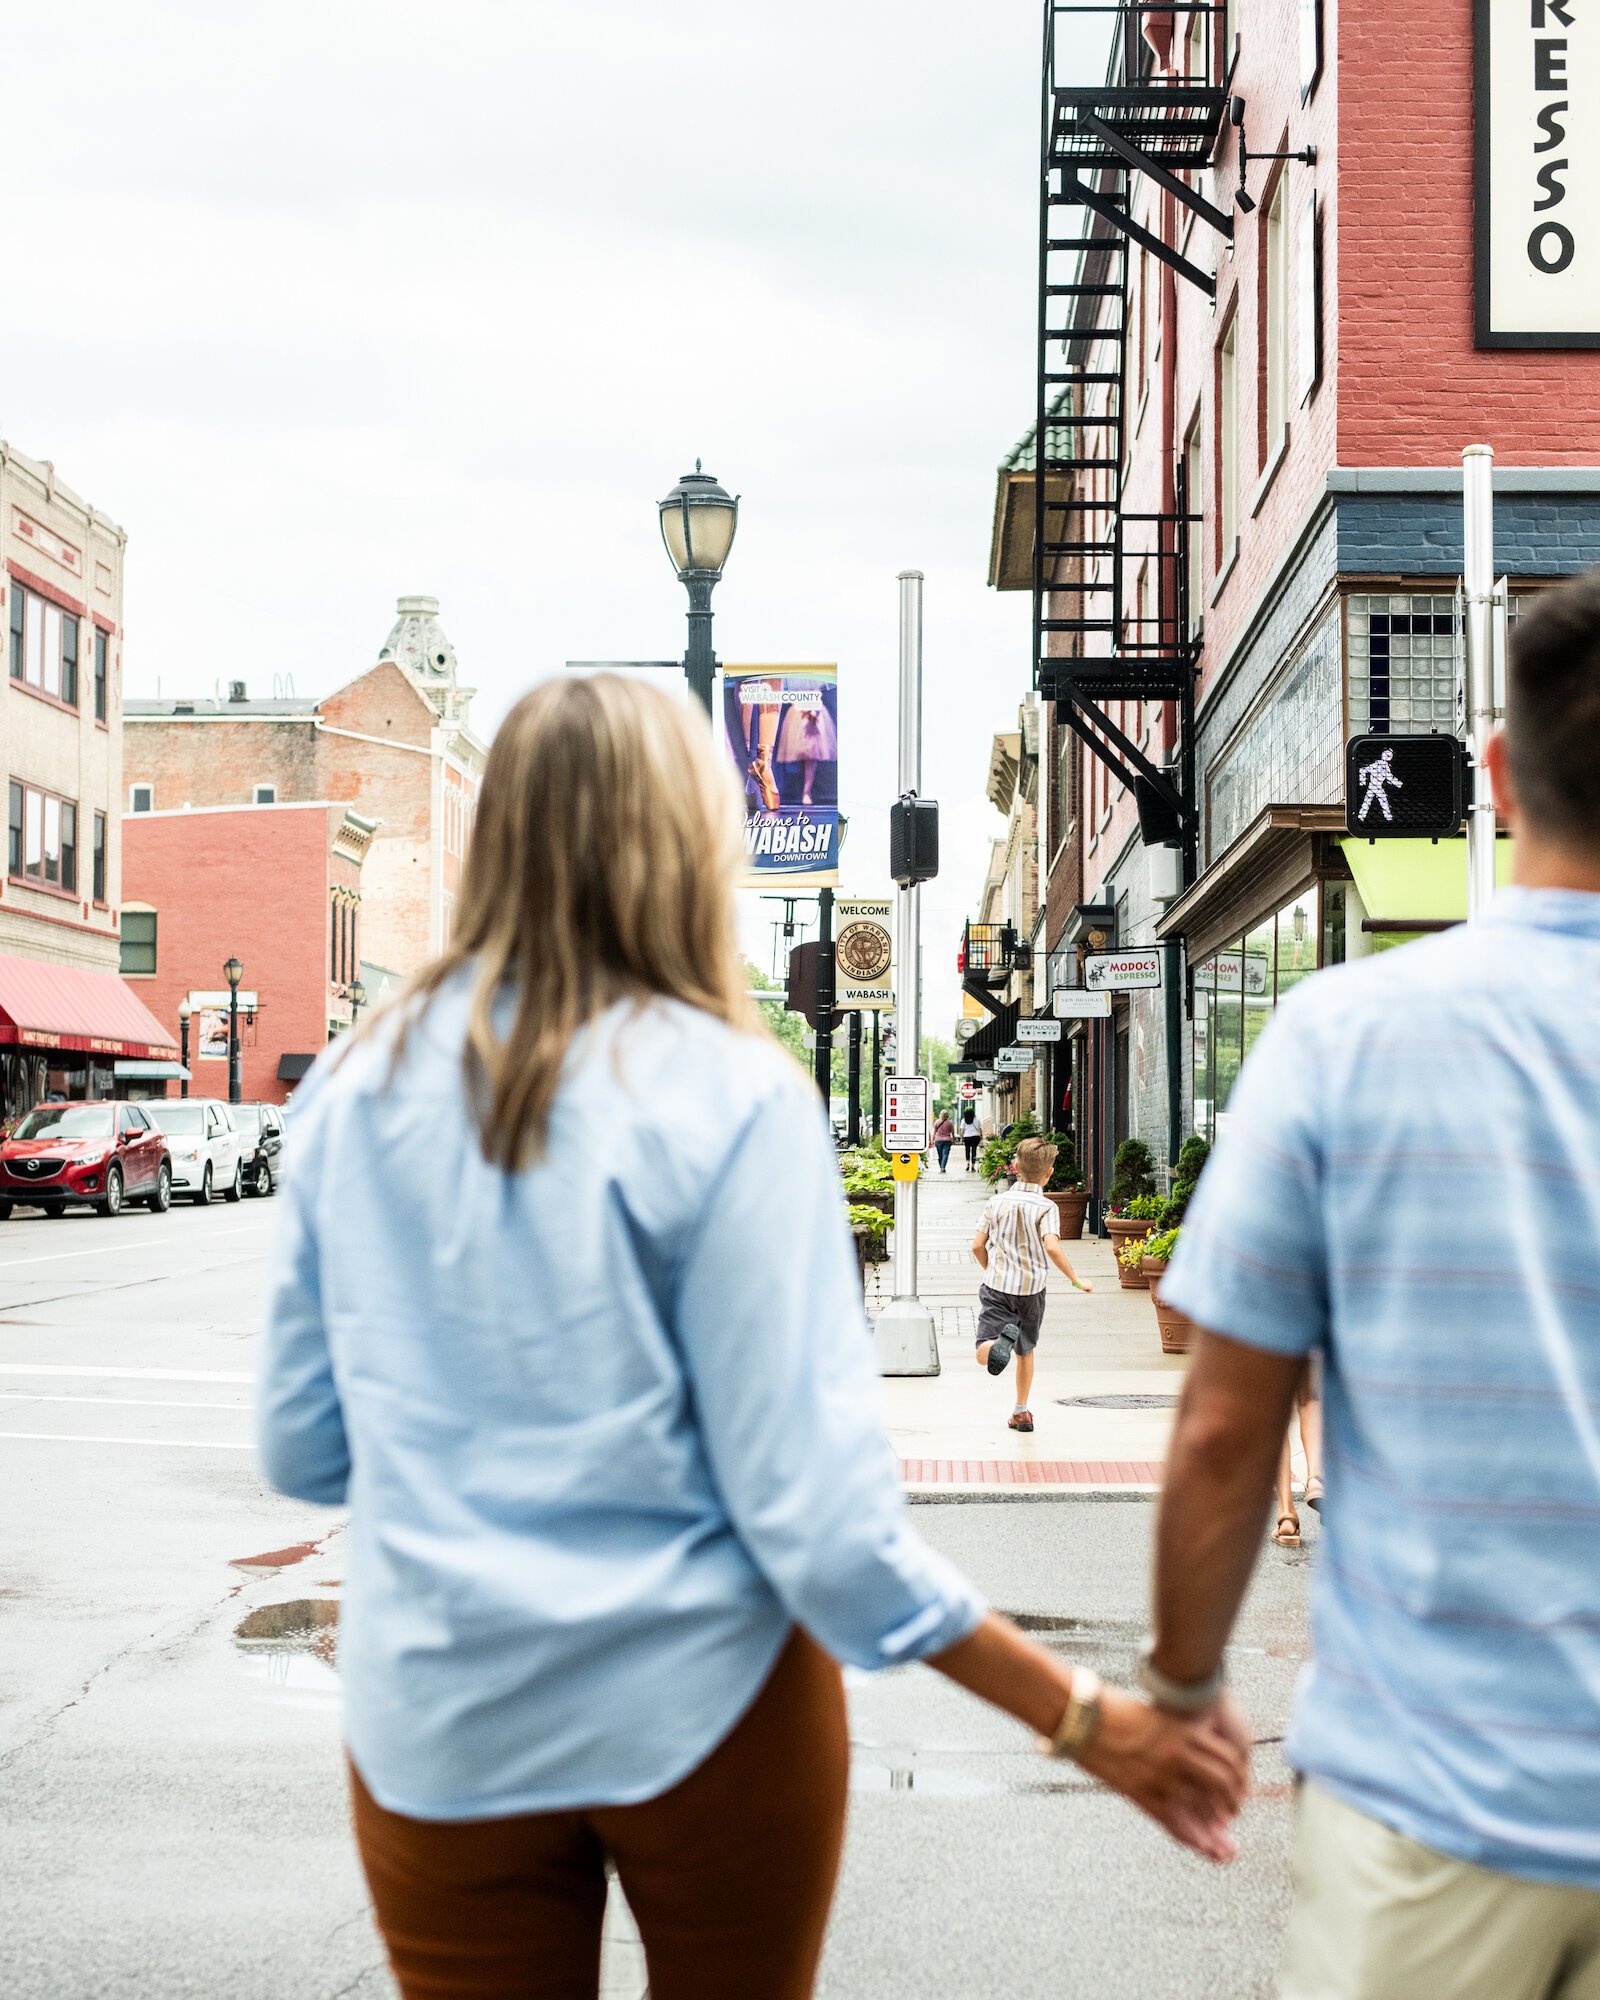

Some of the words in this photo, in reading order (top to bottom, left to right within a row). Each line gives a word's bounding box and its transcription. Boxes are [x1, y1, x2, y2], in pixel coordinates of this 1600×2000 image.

[742, 693, 780, 702] WABASH
[781, 693, 820, 702] COUNTY
[796, 811, 810, 826] to
[773, 852, 828, 862] DOWNTOWN
[839, 906, 890, 915] WELCOME
[838, 934, 849, 954] CITY
[849, 925, 859, 934] OF
[862, 924, 889, 954] WABASH
[846, 965, 882, 977] INDIANA
[1109, 960, 1156, 972] MODOC'S
[1114, 971, 1157, 981] ESPRESSO
[846, 990, 889, 999] WABASH
[1018, 1023, 1060, 1031] THRIFTALICIOUS
